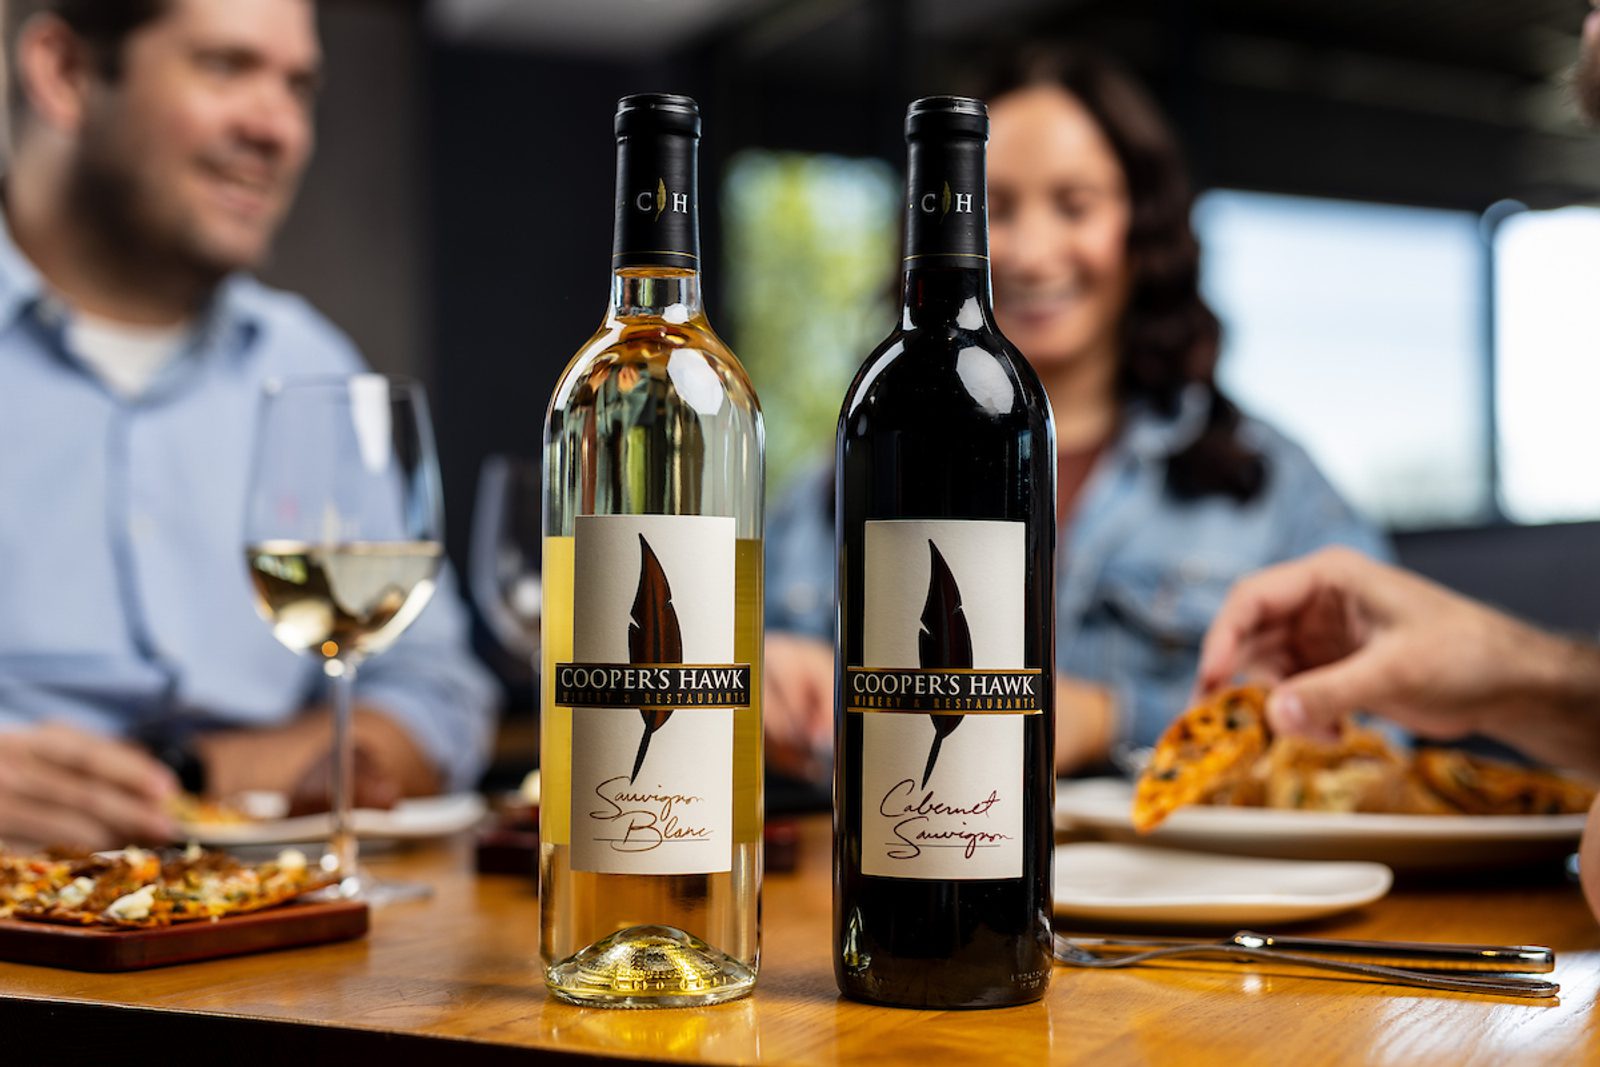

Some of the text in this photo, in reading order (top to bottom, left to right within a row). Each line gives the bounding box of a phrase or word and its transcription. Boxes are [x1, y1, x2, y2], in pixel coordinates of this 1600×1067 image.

[636, 192, 687, 214] C H
[921, 193, 972, 213] C H
[561, 668, 744, 690] COOPER’S HAWK
[853, 673, 1035, 695] COOPER’S HAWK
[934, 698, 1035, 709] RESTAURANTS
[589, 776, 704, 821] Sauvignon
[880, 779, 1000, 818] Cabernet
[610, 811, 713, 852] Blanc
[887, 816, 1013, 859] Sauvignon
